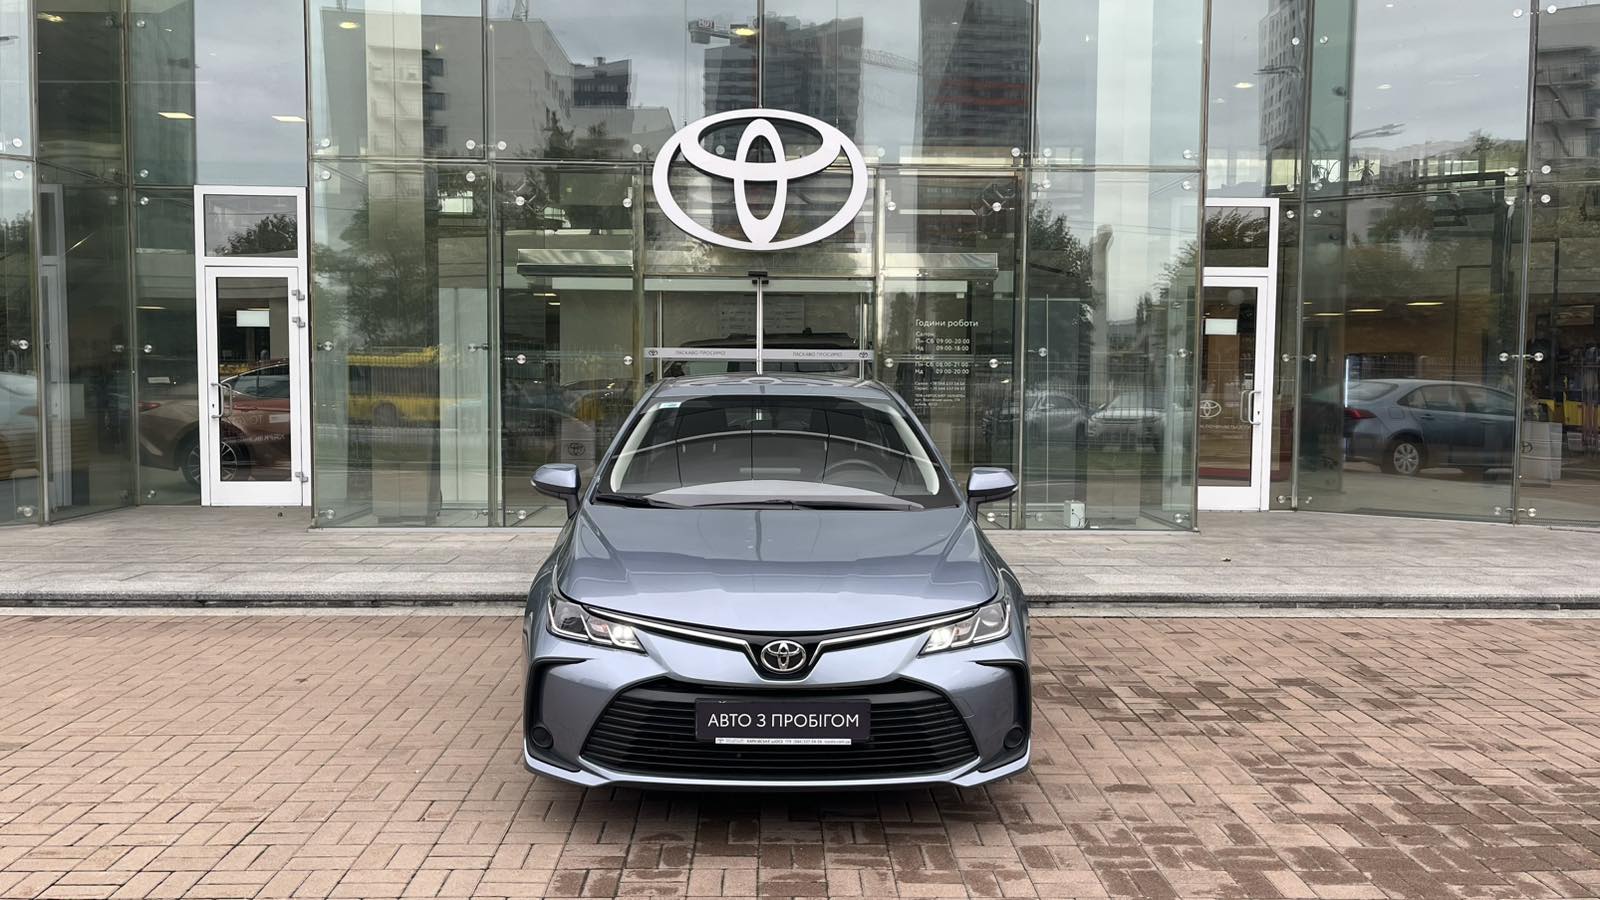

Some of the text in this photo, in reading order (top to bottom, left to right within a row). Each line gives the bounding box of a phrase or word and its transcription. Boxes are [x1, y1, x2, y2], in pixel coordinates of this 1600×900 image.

[915, 319, 979, 328] Години роботи
[707, 713, 859, 728] АВТО З ПРОБІГОМ
